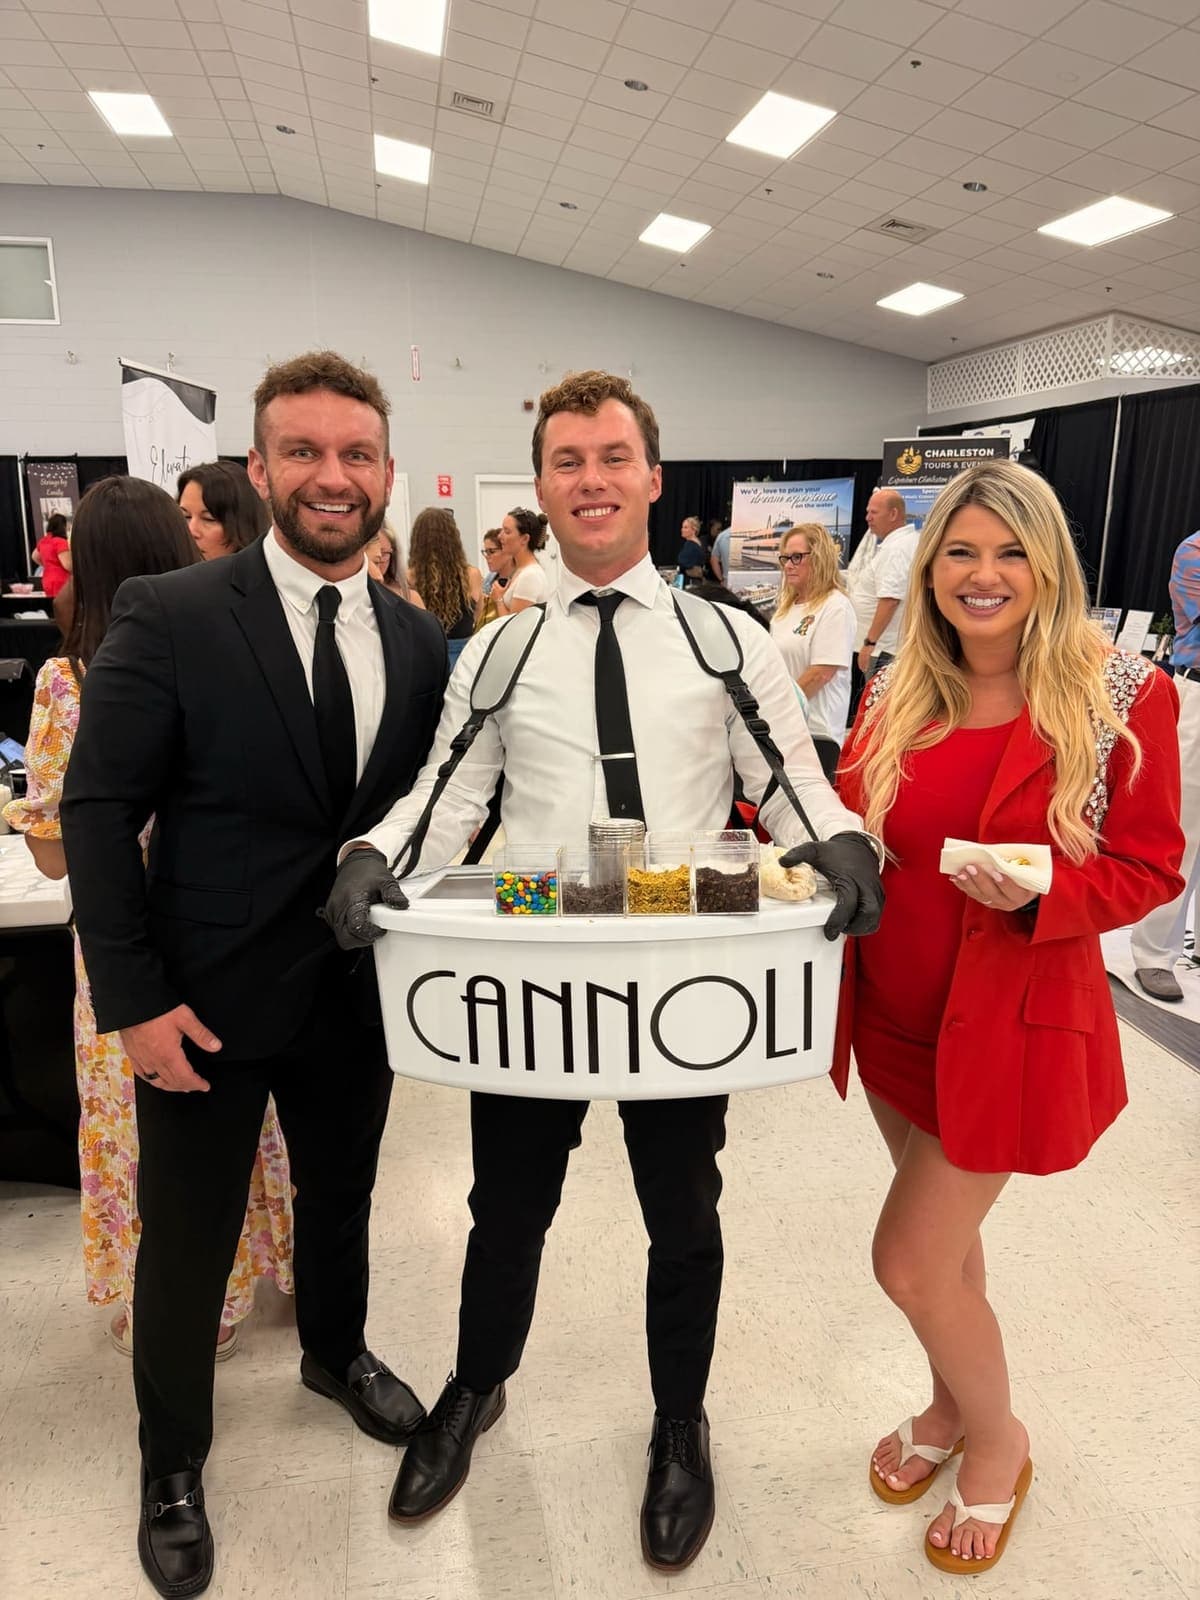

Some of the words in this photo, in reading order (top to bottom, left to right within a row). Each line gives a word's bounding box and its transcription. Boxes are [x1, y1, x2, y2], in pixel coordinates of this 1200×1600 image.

[924, 448, 995, 458] CHARLESTON
[924, 461, 951, 470] TOURS
[953, 461, 959, 469] &
[787, 487, 804, 495] plan
[804, 487, 821, 495] your
[406, 961, 813, 1074] CANNOLI
